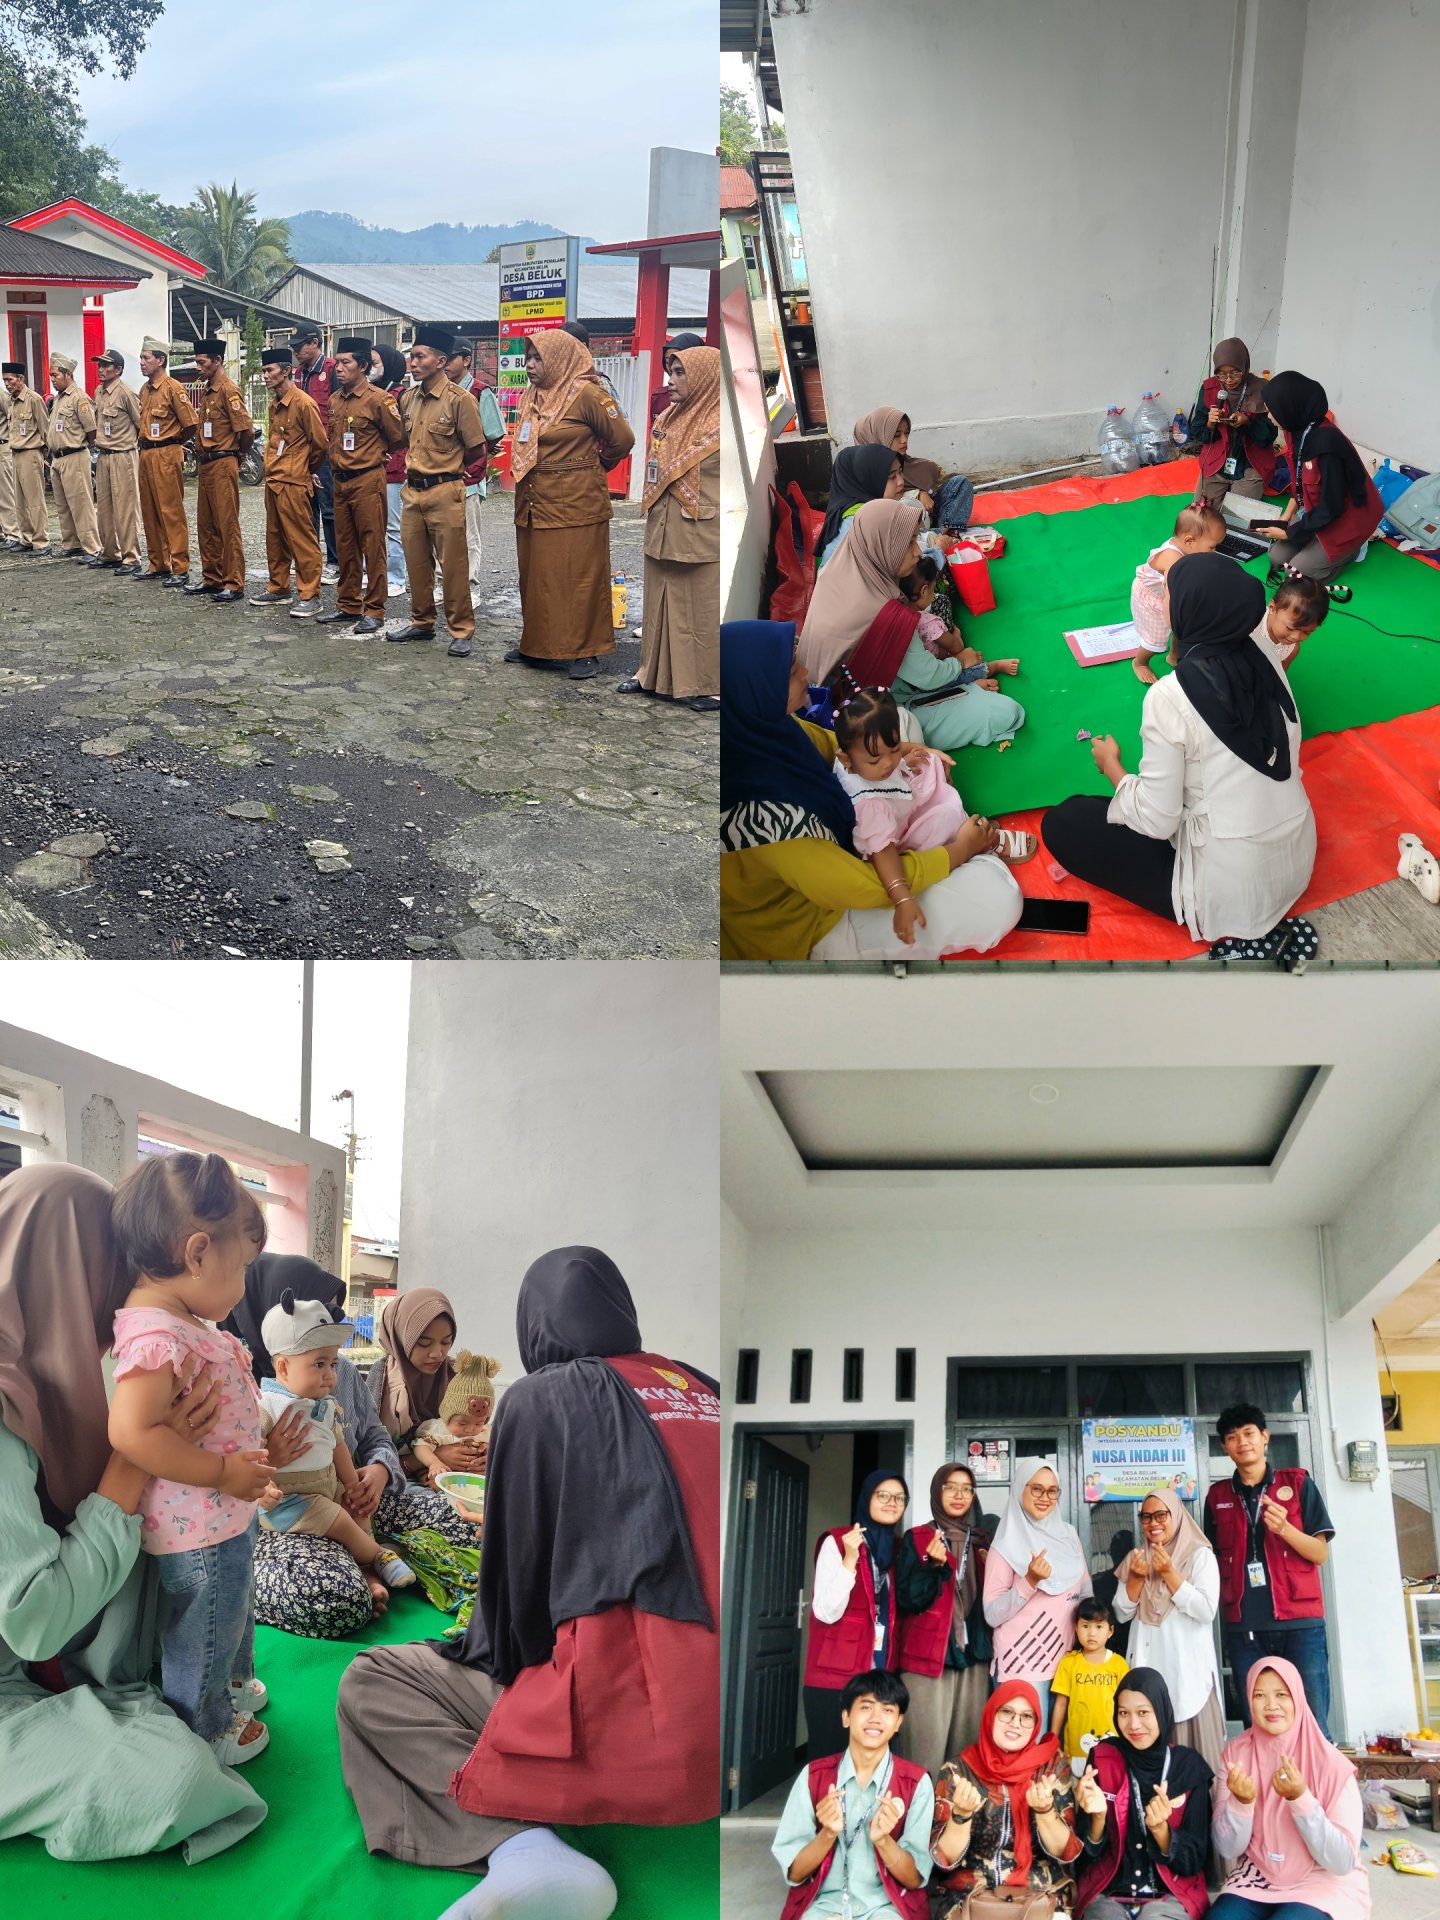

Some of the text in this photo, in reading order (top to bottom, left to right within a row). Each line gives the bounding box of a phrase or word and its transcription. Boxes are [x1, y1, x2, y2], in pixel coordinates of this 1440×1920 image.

[503, 268, 563, 284] DESA BELUK
[526, 289, 545, 299] BPD
[524, 326, 545, 334] KPMD
[633, 1387, 688, 1401] KKN
[666, 1400, 701, 1412] DESA
[648, 1411, 696, 1421] NIVERSITAS
[1095, 1424, 1182, 1438] POSYANDU
[1092, 1448, 1186, 1464] NUSA INDAH III
[1075, 1672, 1118, 1686] RABBIT
